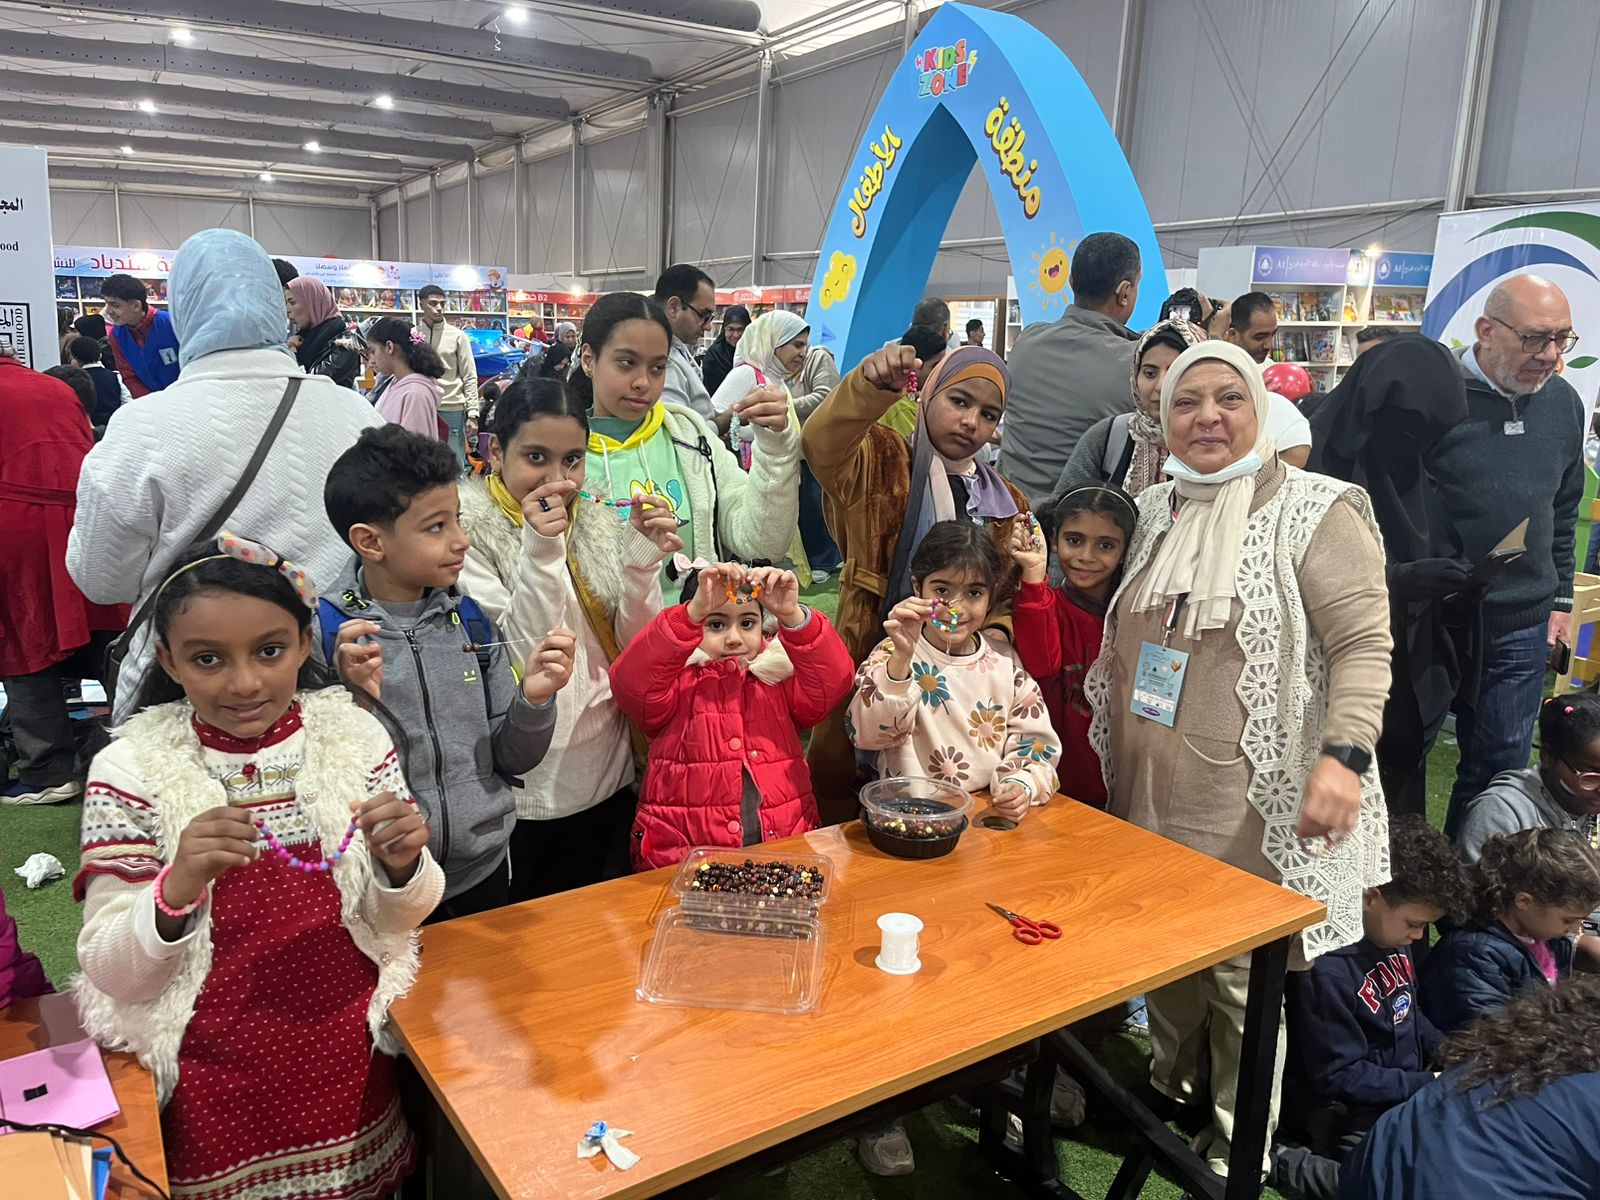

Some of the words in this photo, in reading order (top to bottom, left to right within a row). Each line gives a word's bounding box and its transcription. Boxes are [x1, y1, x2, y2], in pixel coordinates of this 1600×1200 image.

[924, 39, 967, 72] KIDS
[918, 63, 968, 98] ZONE
[984, 96, 1041, 220] منطقة
[848, 124, 903, 239] الأطفال
[0, 197, 24, 214] المج
[0, 241, 19, 251] ood
[53, 256, 76, 268] للنش
